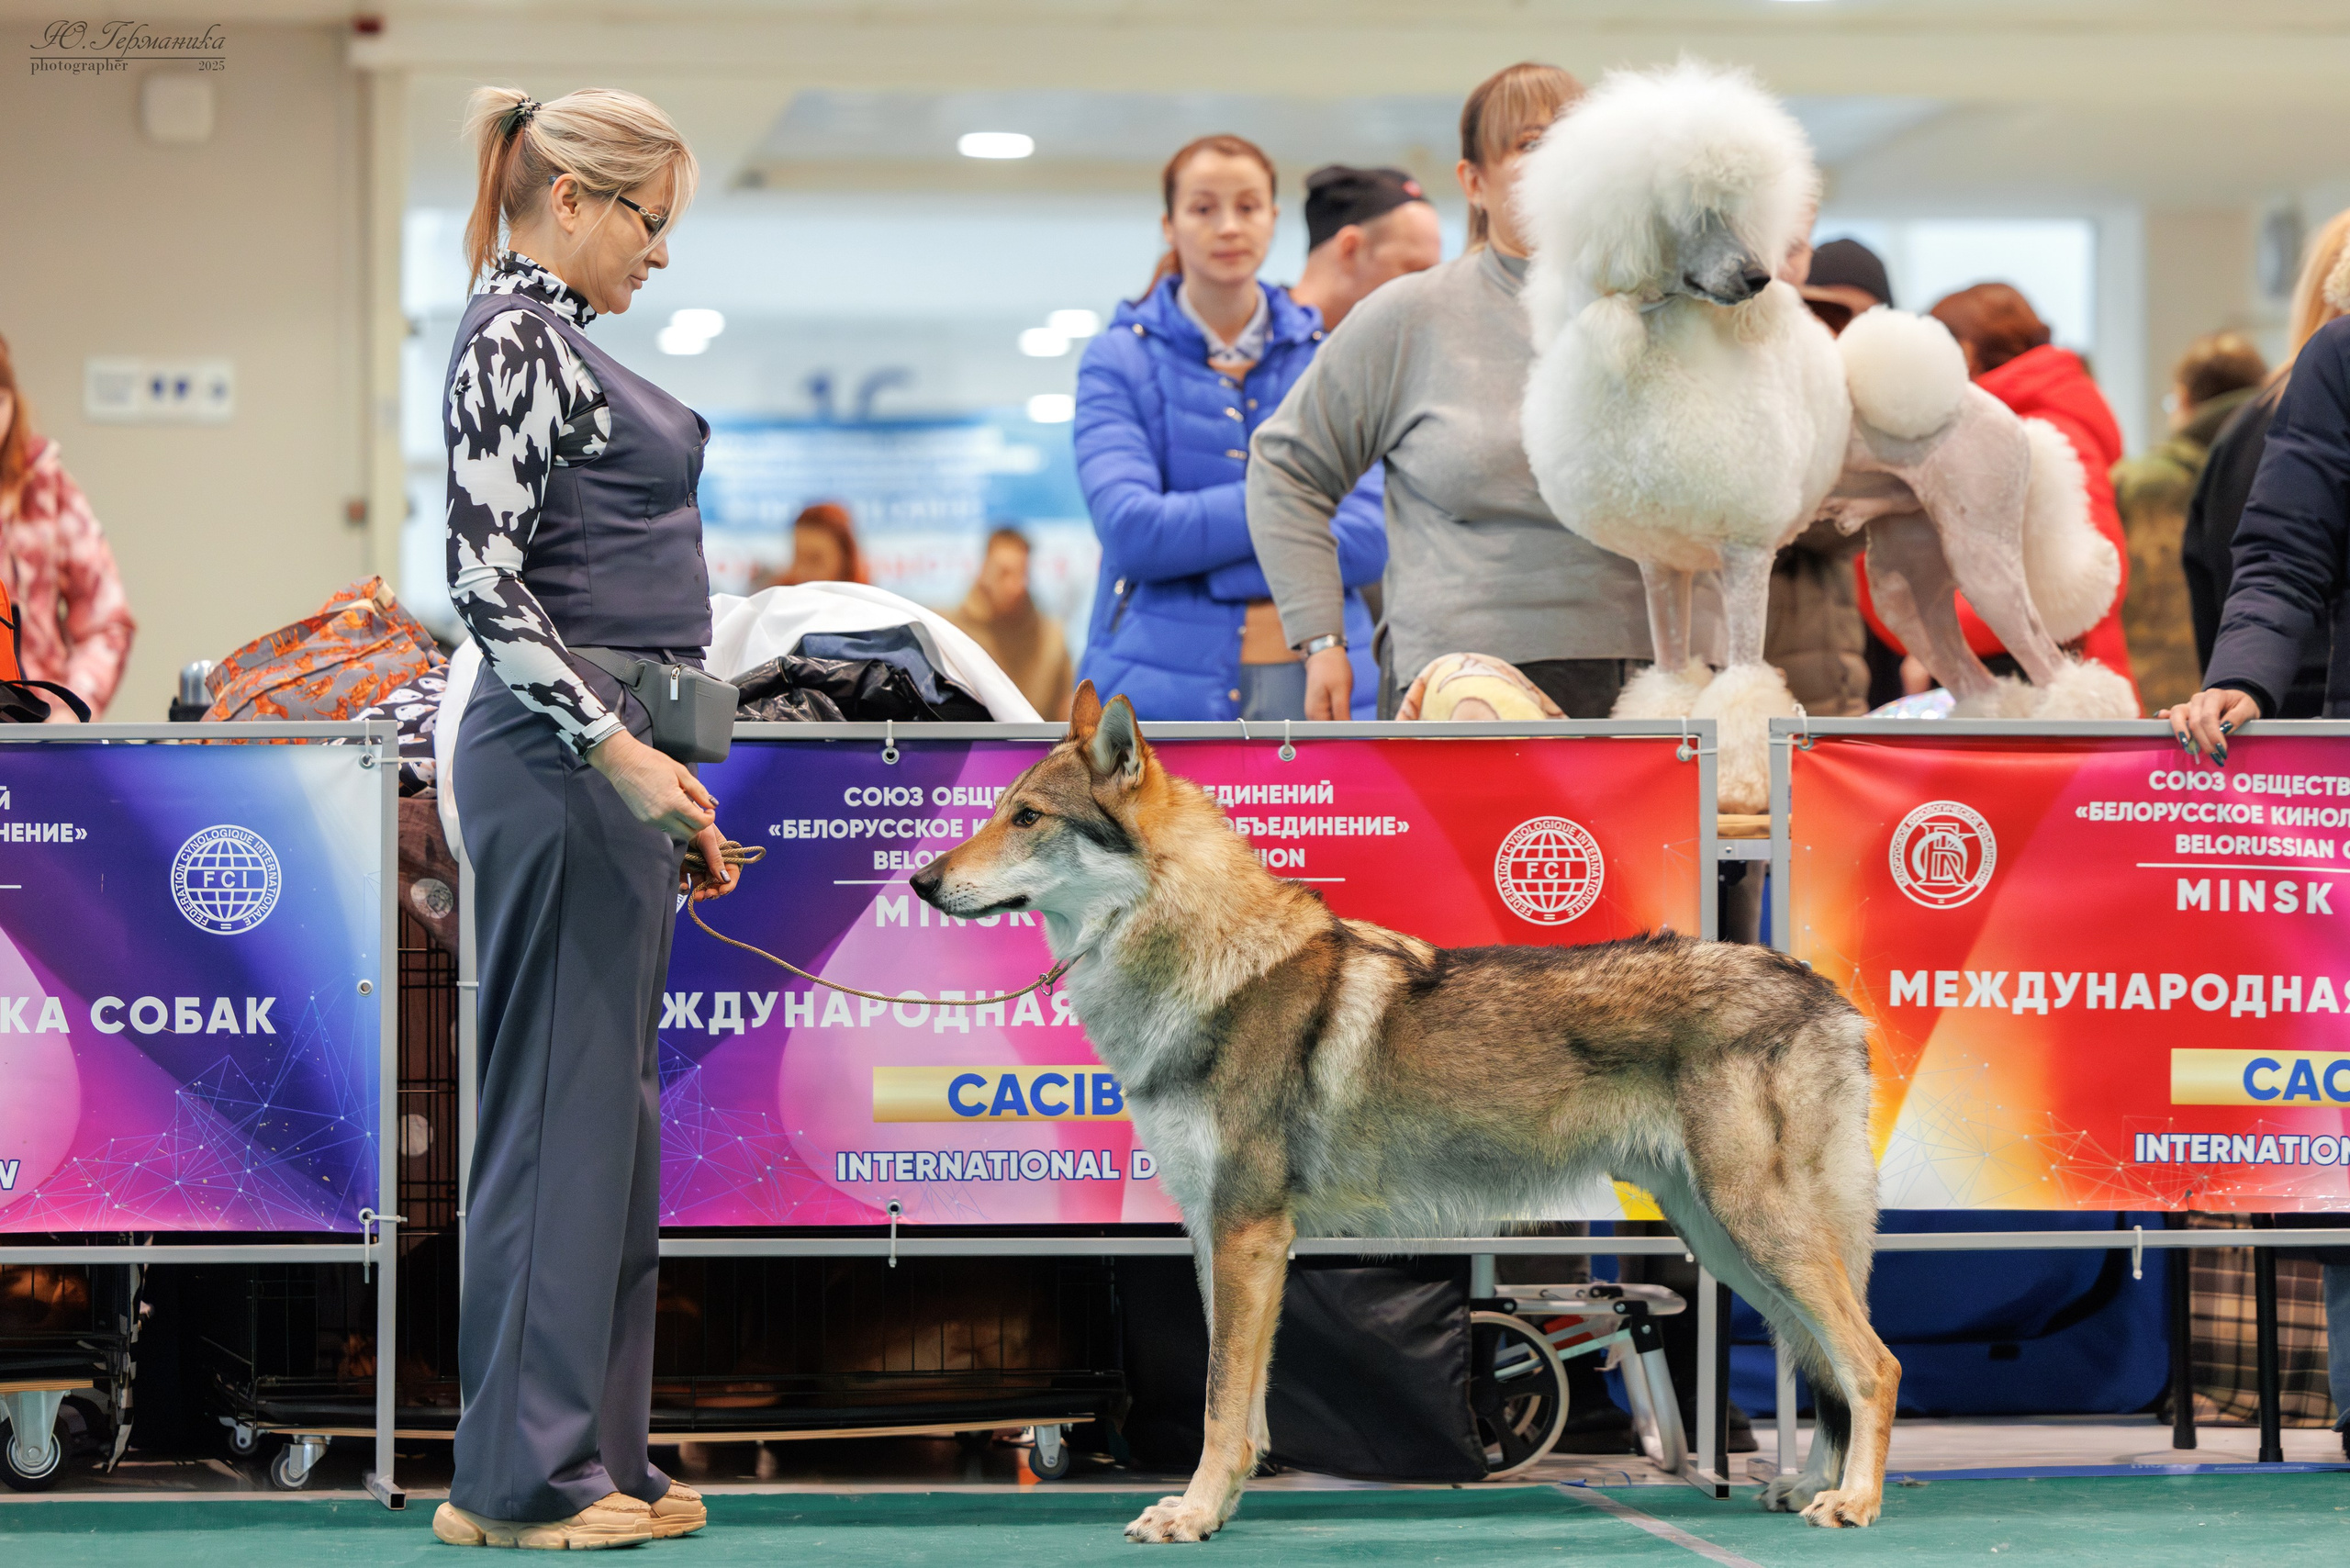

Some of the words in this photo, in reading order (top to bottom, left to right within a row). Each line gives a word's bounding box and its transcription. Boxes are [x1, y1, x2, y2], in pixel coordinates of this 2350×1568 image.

[844, 786, 924, 807] СОЮЗ
[2148, 769, 2227, 791] СОЮЗ
[2232, 772, 2350, 799] ОБЩЕСТВ
[768, 818, 964, 839] «БЕЛОРУССКОЕ
[2075, 801, 2265, 825] «БЕЛОРУССКОЕ
[181, 828, 255, 862] CYNOLOGIQUE
[1504, 820, 1578, 854] CYNOLOGIQUE
[2176, 834, 2335, 859] BELORUSSIAN
[203, 870, 248, 889] FCI
[242, 841, 278, 926] INTERNATIONALE
[1499, 855, 1534, 917] FEDERATION
[1526, 861, 1571, 879] FCI
[1565, 832, 1600, 916] INTERNATIONALE
[174, 863, 210, 927] FEDERATION
[2176, 878, 2334, 915] MINSK
[1889, 969, 2350, 1019] МЕЖДУНАРОДНА
[90, 995, 278, 1035] СОБАК
[947, 1072, 1125, 1117] CACIB
[836, 1150, 1120, 1182] INTERNATIONAL
